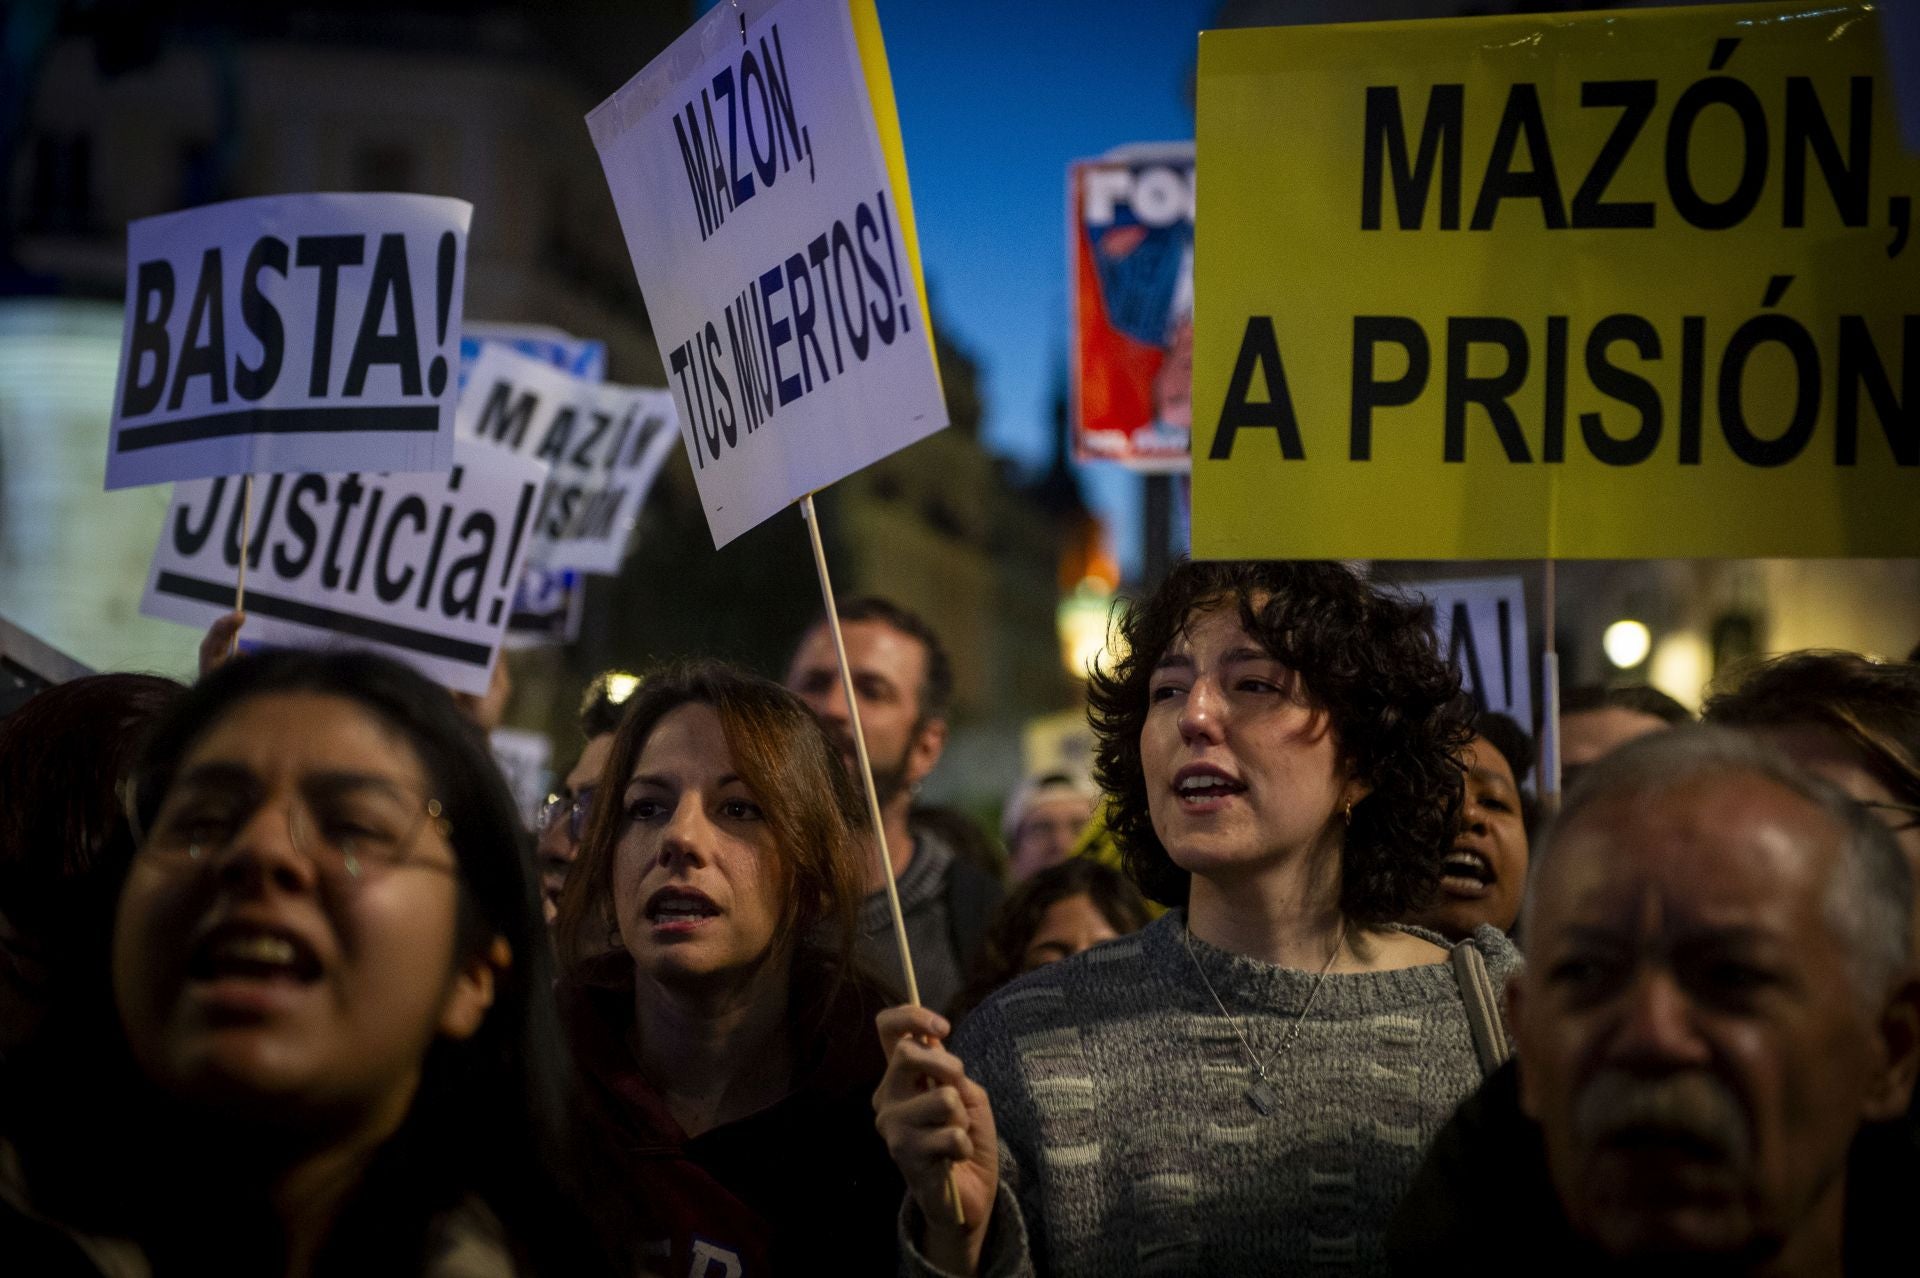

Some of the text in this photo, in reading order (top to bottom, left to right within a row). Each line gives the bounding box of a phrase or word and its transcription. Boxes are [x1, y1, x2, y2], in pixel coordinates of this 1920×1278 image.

[673, 13, 816, 242] MAZÓN,
[1083, 167, 1195, 228] FO
[1360, 38, 1912, 259] MAZÓN,
[121, 231, 456, 419] BASTA!
[669, 190, 912, 470] TUS MUERTOS!
[1208, 275, 1920, 469] A PRISIÓN
